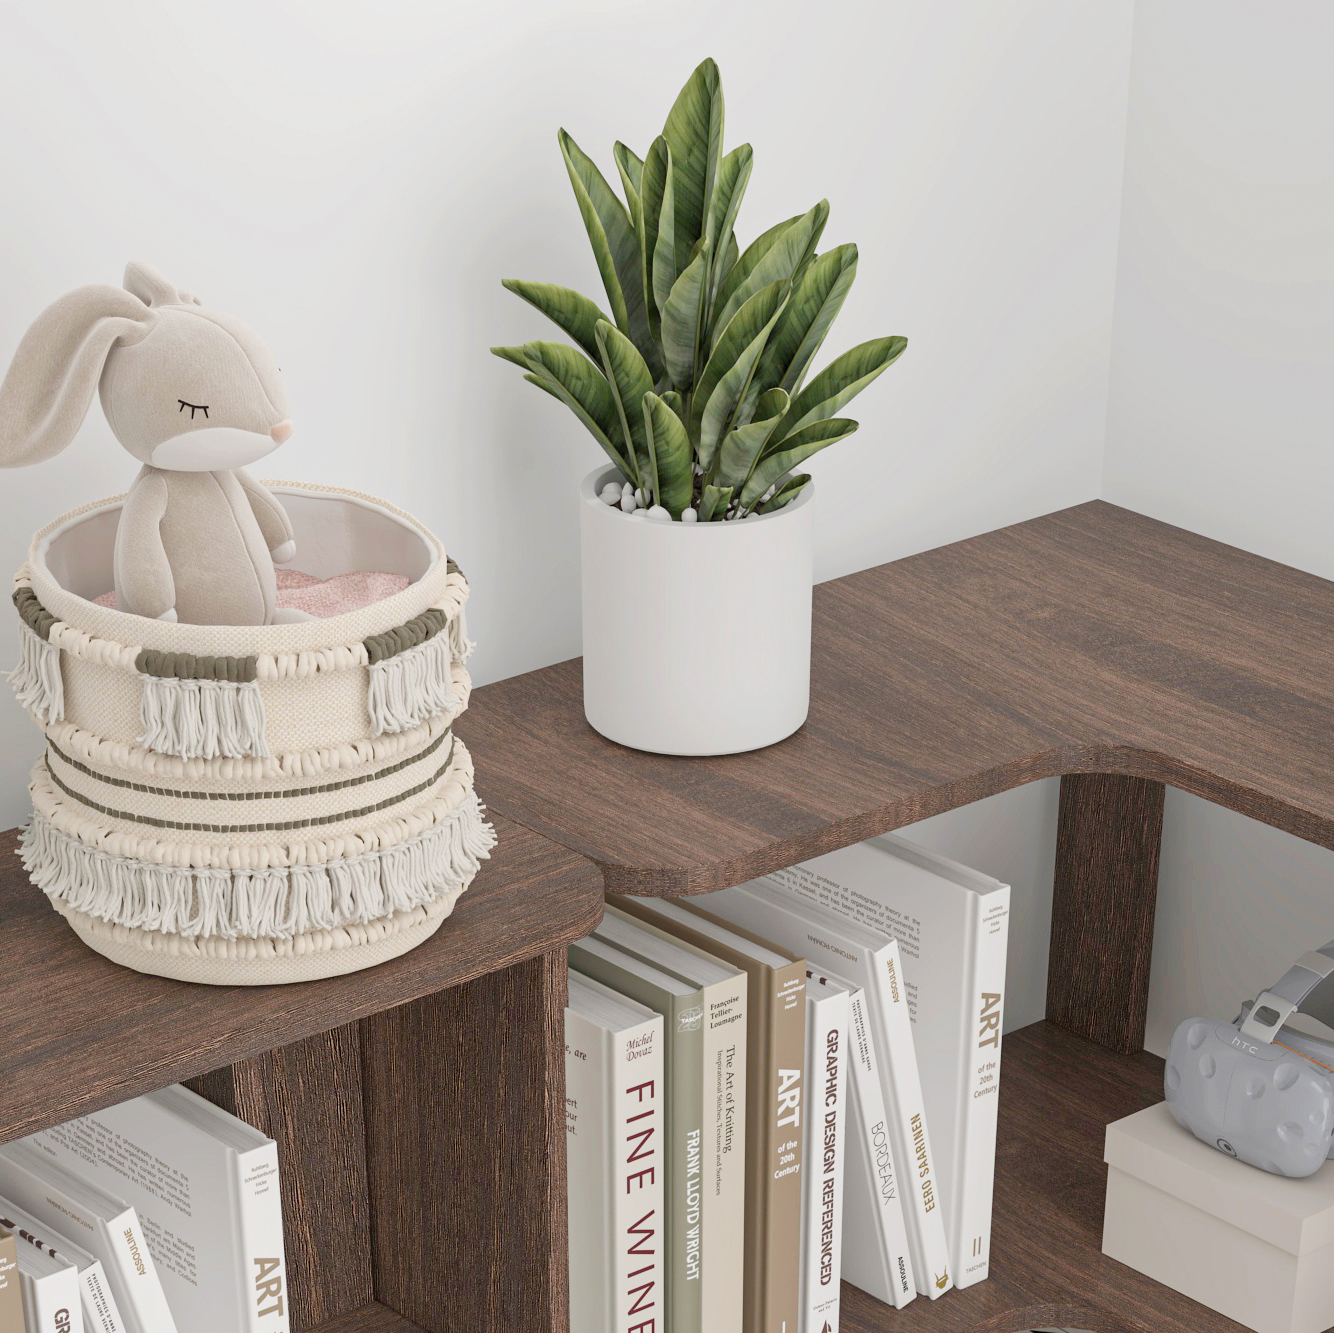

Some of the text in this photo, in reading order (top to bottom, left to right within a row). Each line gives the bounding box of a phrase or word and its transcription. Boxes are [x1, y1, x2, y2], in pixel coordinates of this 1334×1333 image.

[981, 991, 1001, 1050] ART
[626, 1079, 655, 1194] FINE
[723, 1045, 736, 1153] The Art of Knitting
[777, 1069, 800, 1127] ART
[820, 1029, 839, 1286] GRAPHIC DESIGN REFERENCED
[871, 1121, 896, 1205] BORDEAUX
[910, 1113, 935, 1214] EERO SAARINEN
[686, 1129, 700, 1280] FRANK LLOYD WRIGHT
[124, 1228, 146, 1276] ASSOULINE
[254, 1258, 283, 1318] ART
